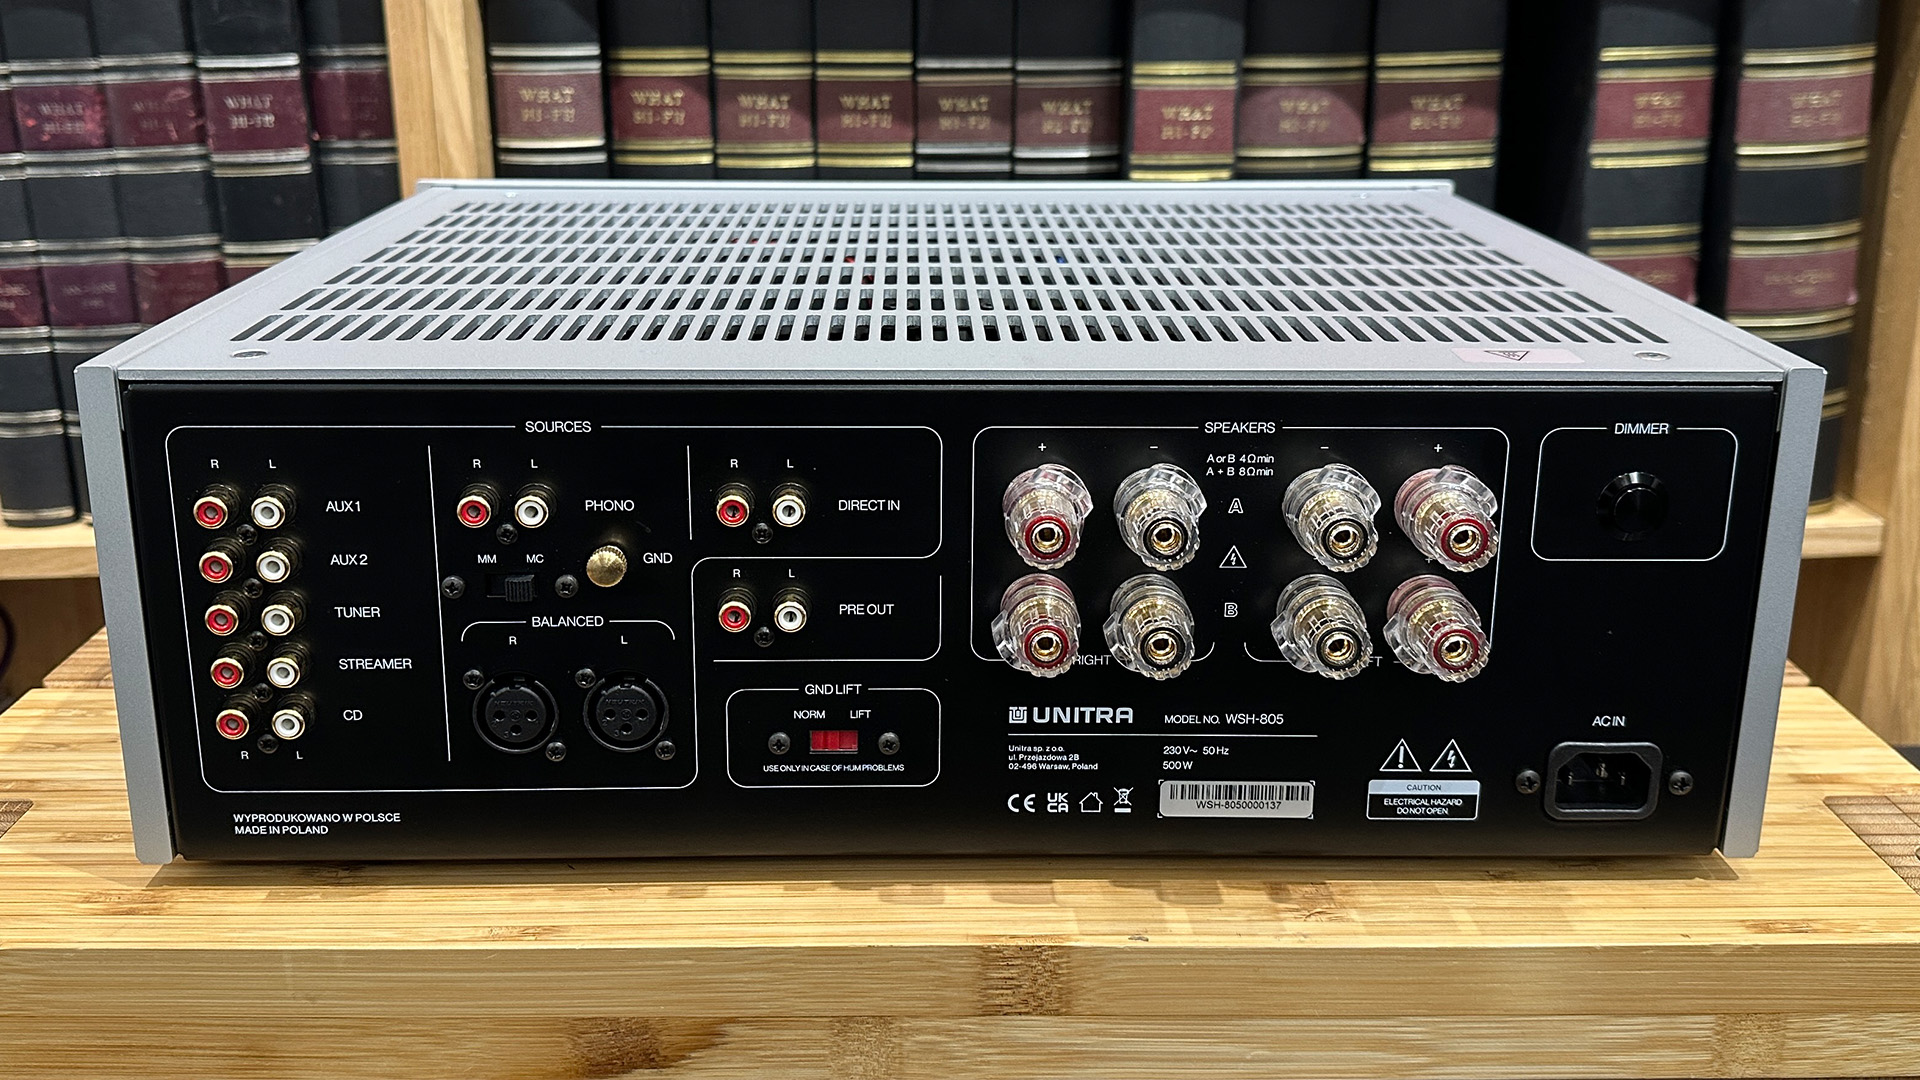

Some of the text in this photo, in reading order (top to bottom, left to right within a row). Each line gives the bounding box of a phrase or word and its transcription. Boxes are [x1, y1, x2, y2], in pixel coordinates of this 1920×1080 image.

[525, 421, 591, 432] SOURCES
[1205, 422, 1275, 433] SPEAKERS
[1615, 423, 1669, 434] DIMMER
[211, 459, 219, 468] R
[269, 460, 276, 468] L
[473, 459, 481, 468] R
[531, 459, 538, 468] L
[731, 459, 738, 468] R
[787, 459, 793, 468] L
[1227, 467, 1234, 476] B
[586, 500, 634, 511] PHONO
[839, 500, 900, 511] DIRECT IN
[1228, 498, 1243, 513] A
[331, 554, 357, 565] AUX
[478, 555, 496, 563] MM
[527, 554, 544, 563] MC
[643, 553, 672, 563] GND
[733, 569, 740, 577] R
[789, 569, 795, 577] L
[334, 607, 380, 618] TUNER
[840, 604, 894, 615] PRE OUT
[1224, 603, 1238, 617] B
[532, 616, 603, 627] BALANCED
[509, 636, 517, 644] R
[621, 636, 627, 644] L
[339, 658, 412, 669] STREAMER
[805, 684, 862, 694] GND LIFT
[343, 710, 362, 720] CD
[794, 710, 825, 719] NORM
[850, 710, 871, 718] LIFT
[1033, 707, 1133, 723] UNITRA
[1165, 714, 1283, 724] MODEL NO. WSH-805
[1592, 716, 1625, 726] AC IN
[241, 751, 249, 759] R
[297, 751, 303, 759] L
[1019, 754, 1067, 763] Przejazdowa
[1039, 763, 1070, 771] Warsaw,
[1406, 784, 1442, 792] CAUTION
[1196, 801, 1281, 809] WSH-8050000137
[233, 813, 400, 822] WYPRODUKOWANO W POLSCE
[235, 826, 328, 834] MADE IN POLAND
